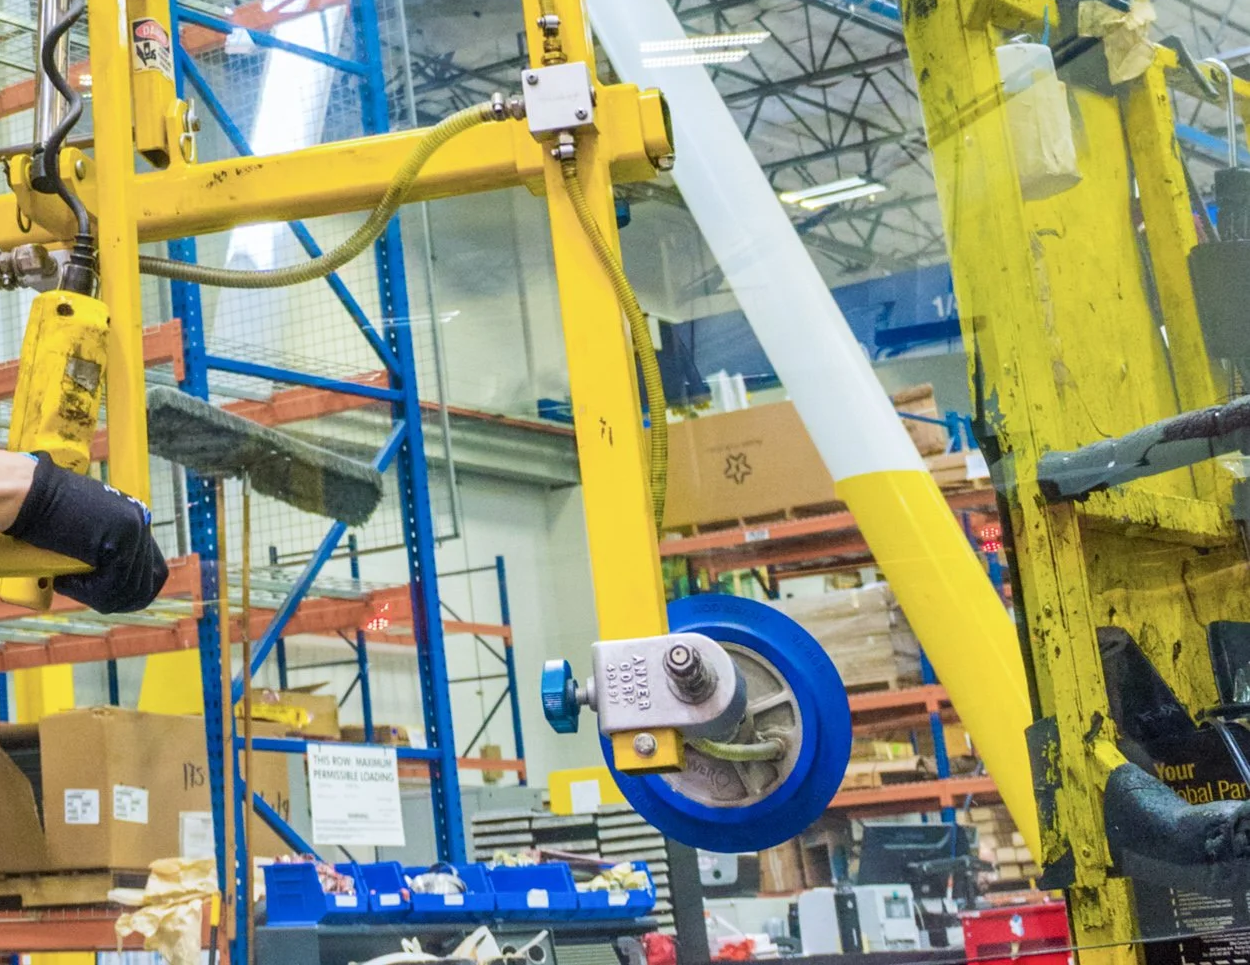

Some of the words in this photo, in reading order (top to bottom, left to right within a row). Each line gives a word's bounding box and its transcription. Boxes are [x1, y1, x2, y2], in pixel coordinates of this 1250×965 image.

[632, 654, 651, 712] ANVER
[313, 755, 330, 766] THIS
[355, 758, 392, 768] MAXIMUM
[313, 770, 358, 782] PERMISSIBLE
[360, 772, 395, 783] LOADING
[1153, 762, 1195, 781] Your
